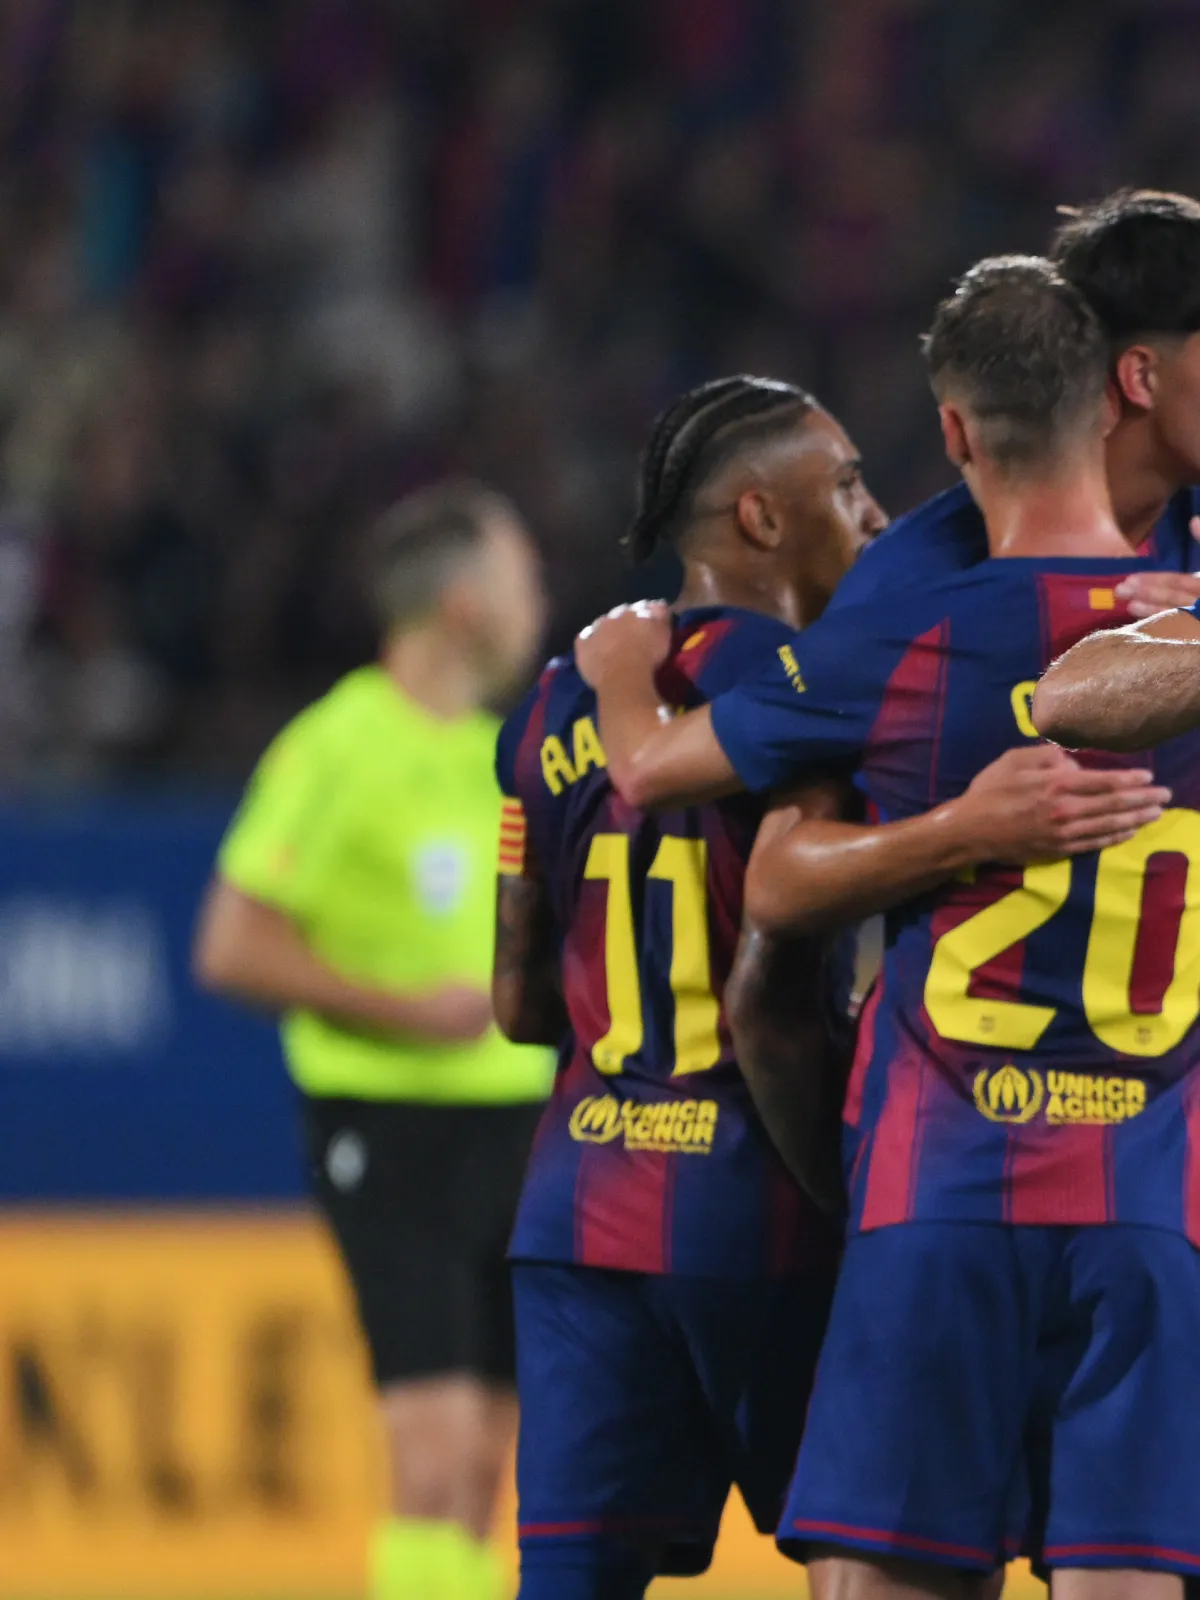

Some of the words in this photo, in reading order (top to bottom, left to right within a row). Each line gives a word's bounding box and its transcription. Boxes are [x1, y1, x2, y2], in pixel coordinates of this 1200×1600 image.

[584, 833, 720, 1077] 11
[1046, 1069, 1146, 1103] UNHCR
[621, 1099, 719, 1124] UNHCR
[1045, 1094, 1144, 1118] ACNUR
